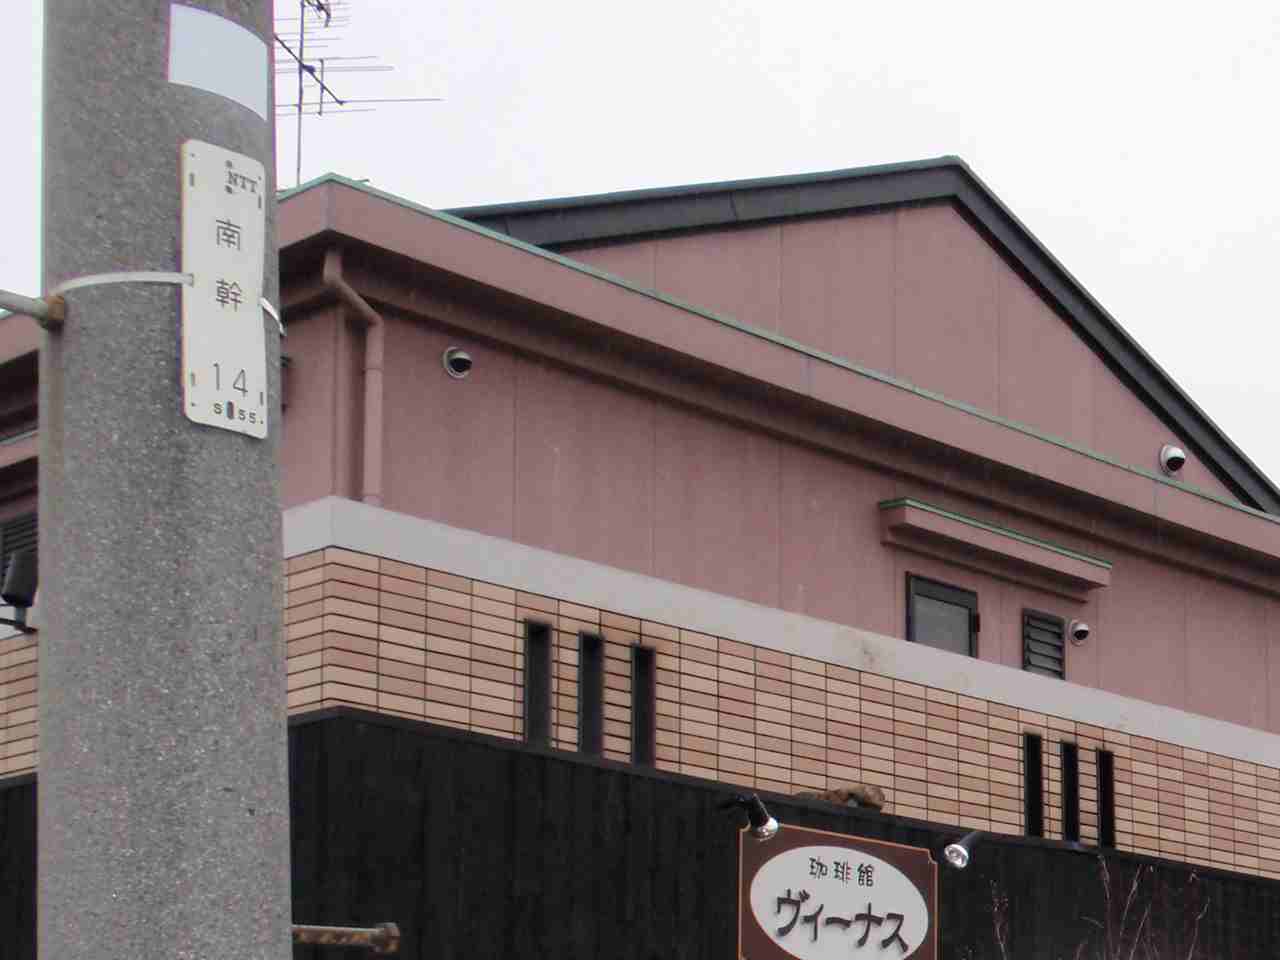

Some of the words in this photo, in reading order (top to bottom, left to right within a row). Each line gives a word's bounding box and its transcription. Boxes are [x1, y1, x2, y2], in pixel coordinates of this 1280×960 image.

[228, 170, 257, 193] NTT
[213, 362, 248, 398] 14
[808, 856, 875, 887] 珈琲館
[775, 888, 909, 953] ヴィーナス
